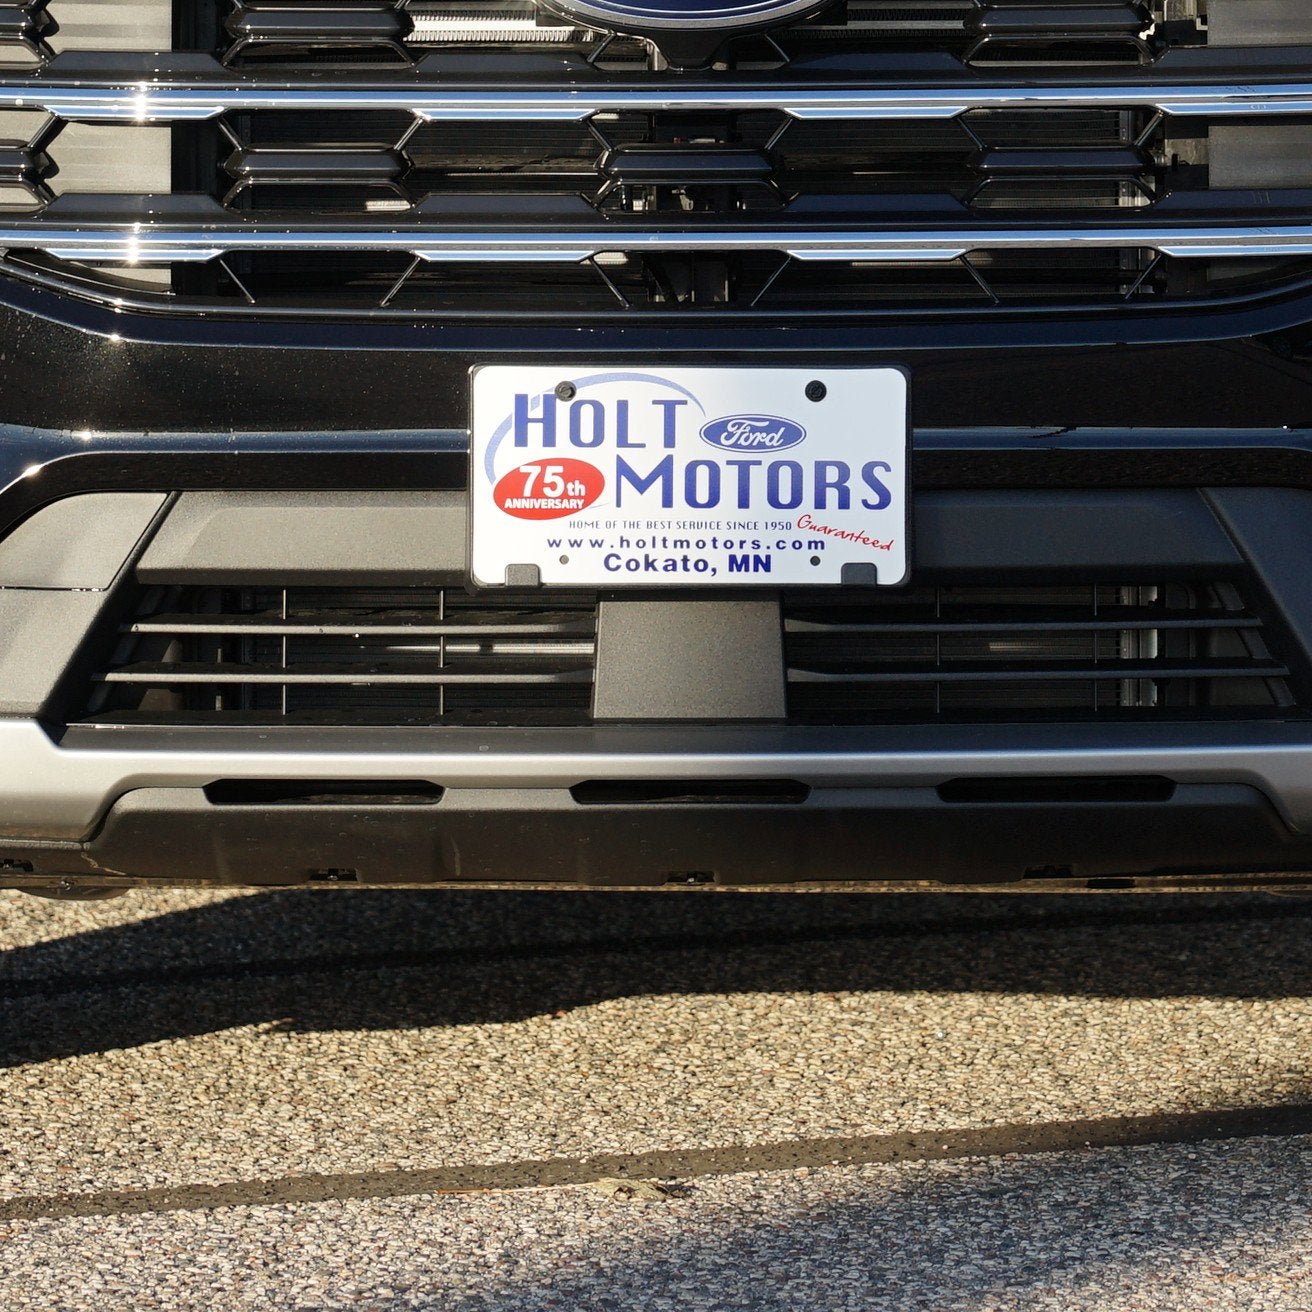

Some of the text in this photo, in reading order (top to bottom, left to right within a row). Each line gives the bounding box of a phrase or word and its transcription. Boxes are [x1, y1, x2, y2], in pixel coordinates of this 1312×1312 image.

[514, 393, 687, 449] HOLT
[720, 419, 784, 447] Ford
[519, 465, 586, 497] 75th
[615, 454, 892, 510] MOTORS
[504, 497, 584, 510] ANNIVERSARY
[569, 520, 792, 531] HOME OF THE BEST SERVICE SINCE 1950
[797, 514, 894, 552] Guaranteed
[547, 536, 826, 550] www.holtmotors.com
[603, 553, 772, 576] Cokato, MN
